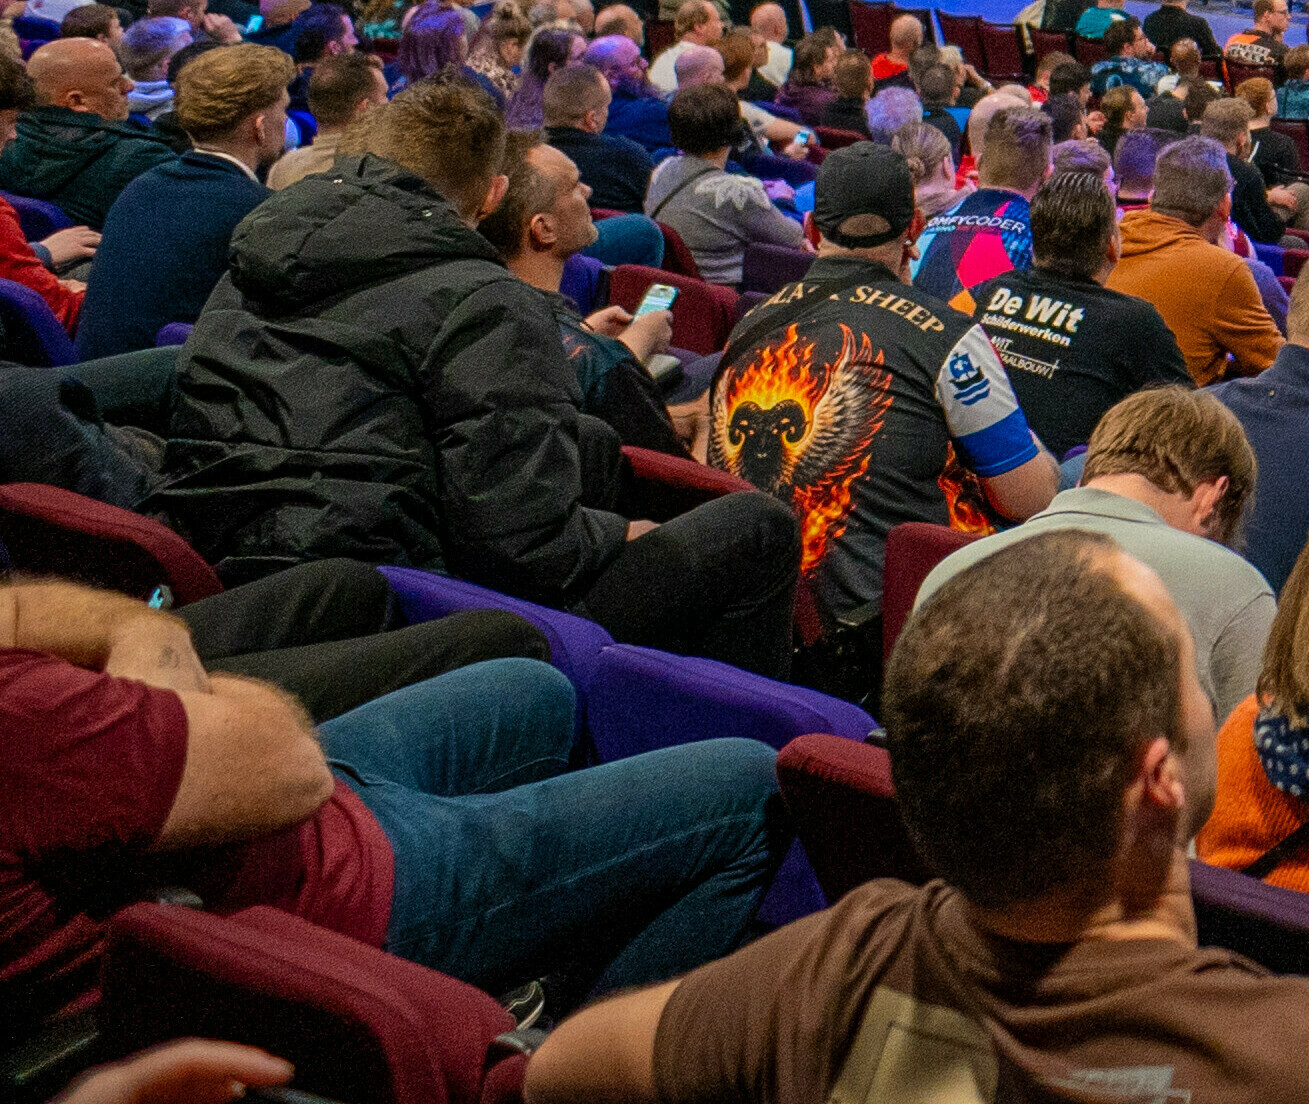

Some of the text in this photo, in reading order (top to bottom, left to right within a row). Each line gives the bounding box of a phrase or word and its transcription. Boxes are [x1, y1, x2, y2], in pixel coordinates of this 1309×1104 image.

[849, 285, 945, 333] SHEEP
[986, 287, 1086, 333] De Wit
